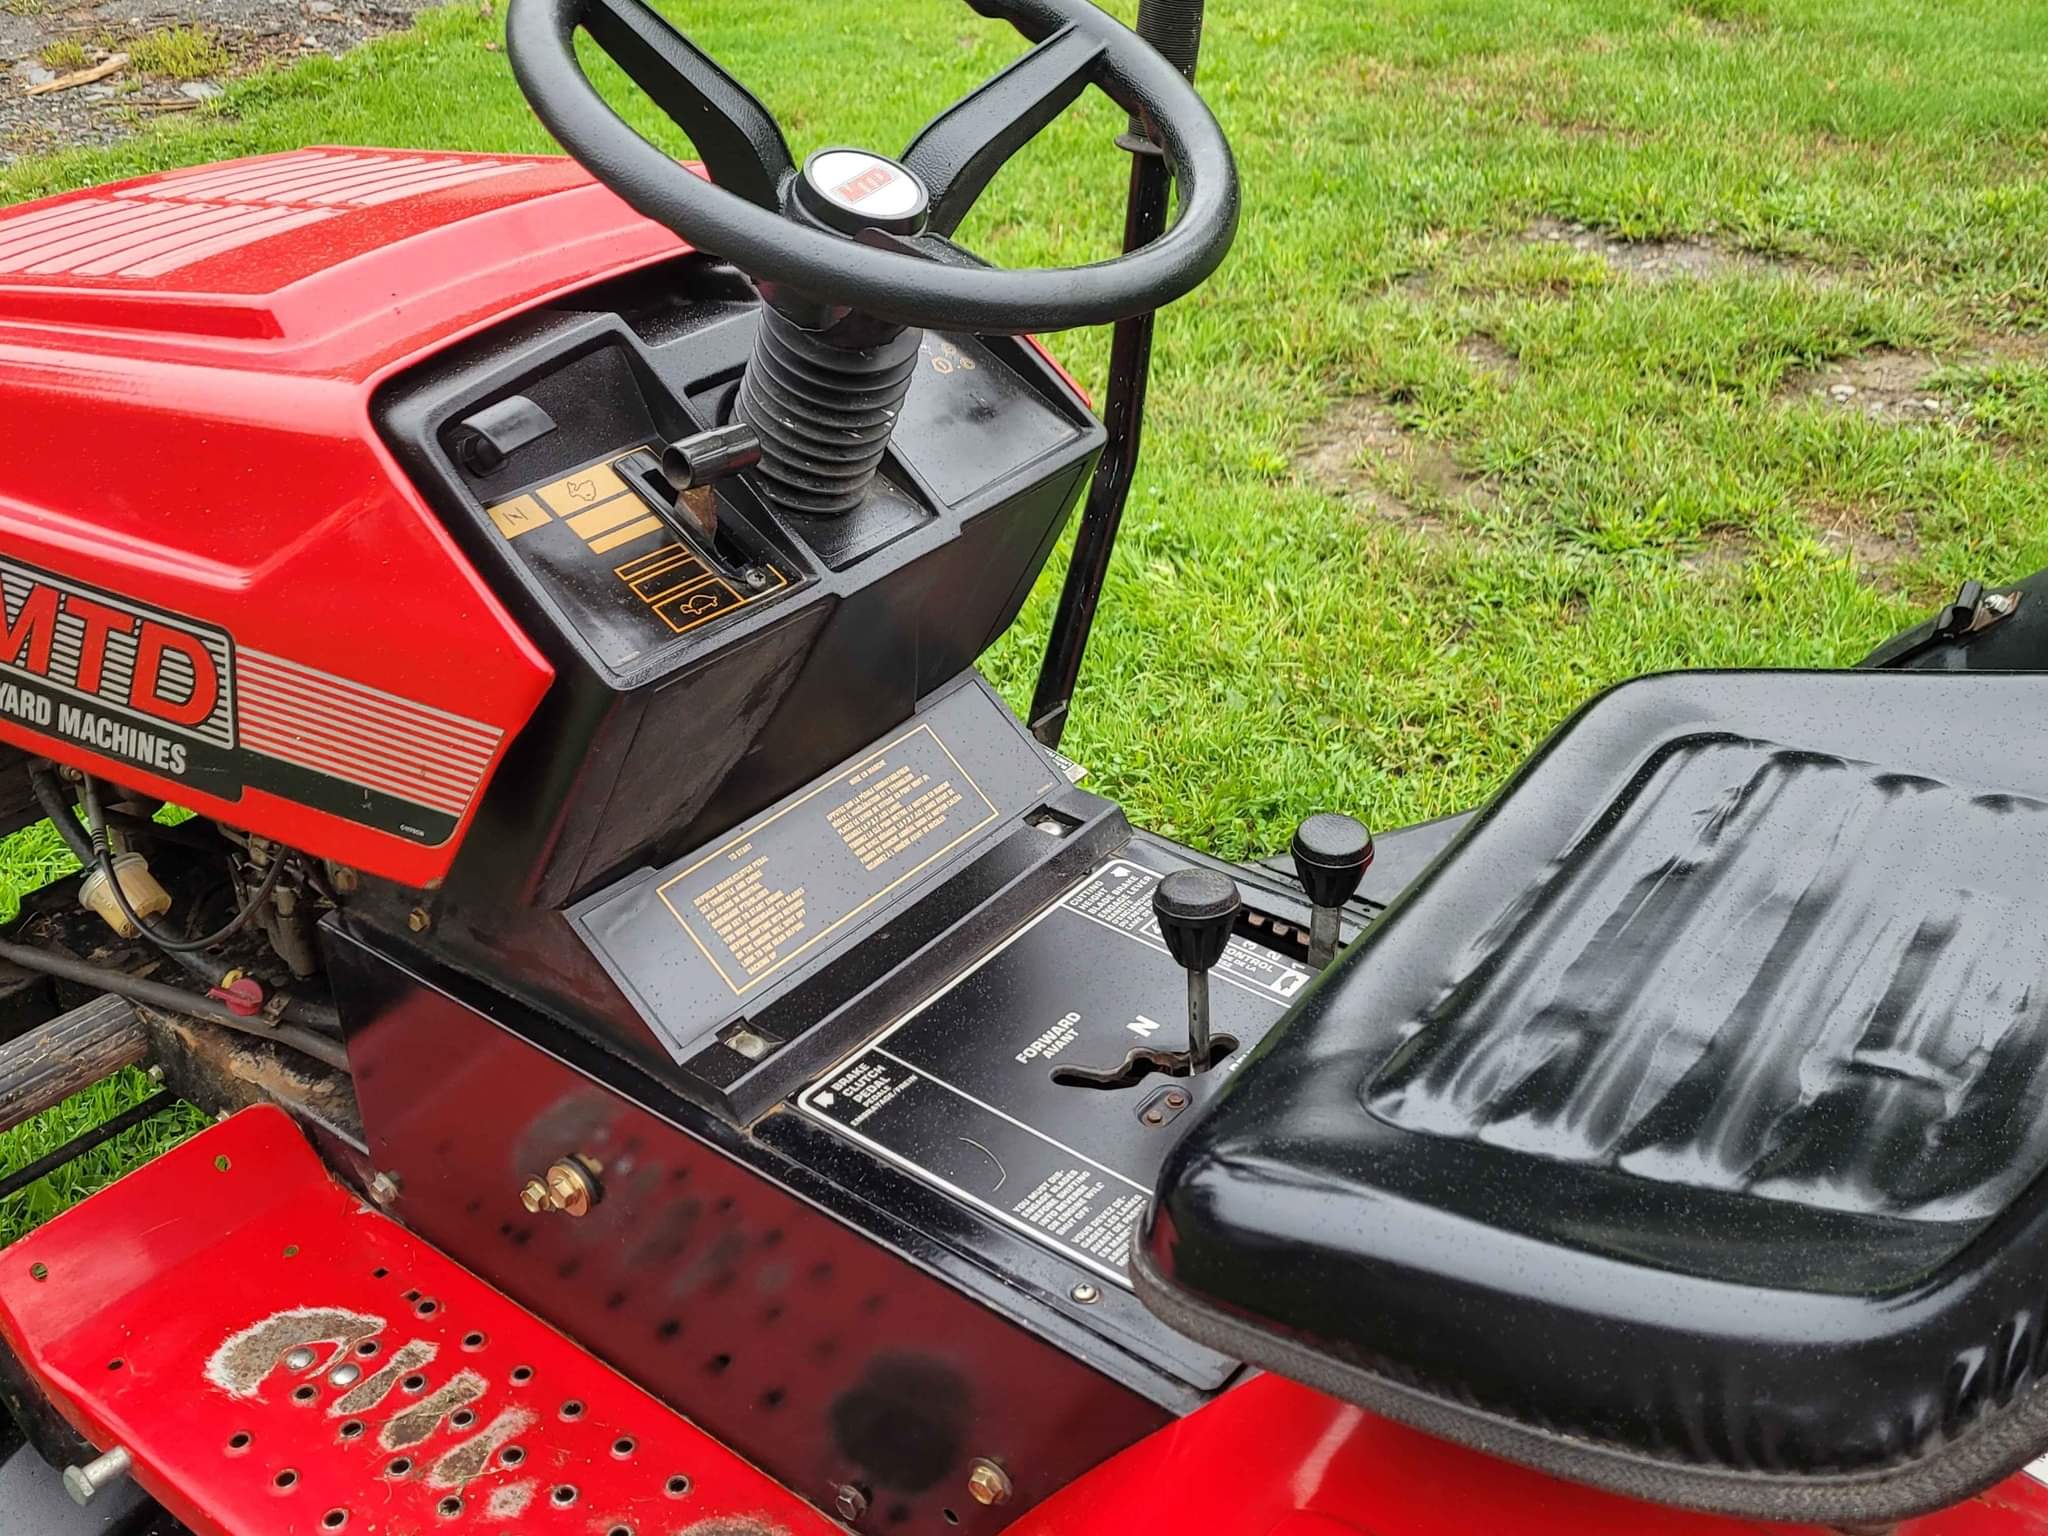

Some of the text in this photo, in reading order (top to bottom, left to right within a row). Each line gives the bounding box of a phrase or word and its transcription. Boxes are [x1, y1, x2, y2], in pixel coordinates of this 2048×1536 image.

[838, 167, 893, 202] MTD
[0, 577, 218, 727] MTD
[58, 703, 187, 775] MACHINES
[1069, 880, 1103, 906] CUTTING
[1078, 887, 1108, 909] HEIGHT
[1087, 874, 1138, 914] BLADE BRAKE
[1126, 875, 1152, 894] LEVER
[1015, 1012, 1081, 1064] FORWARD
[1126, 1014, 1160, 1037] N
[1043, 1028, 1080, 1060] AVANT
[830, 1062, 870, 1091] BRAKE
[841, 1064, 885, 1096] CLUTCH
[852, 1074, 891, 1102] PEDAL
